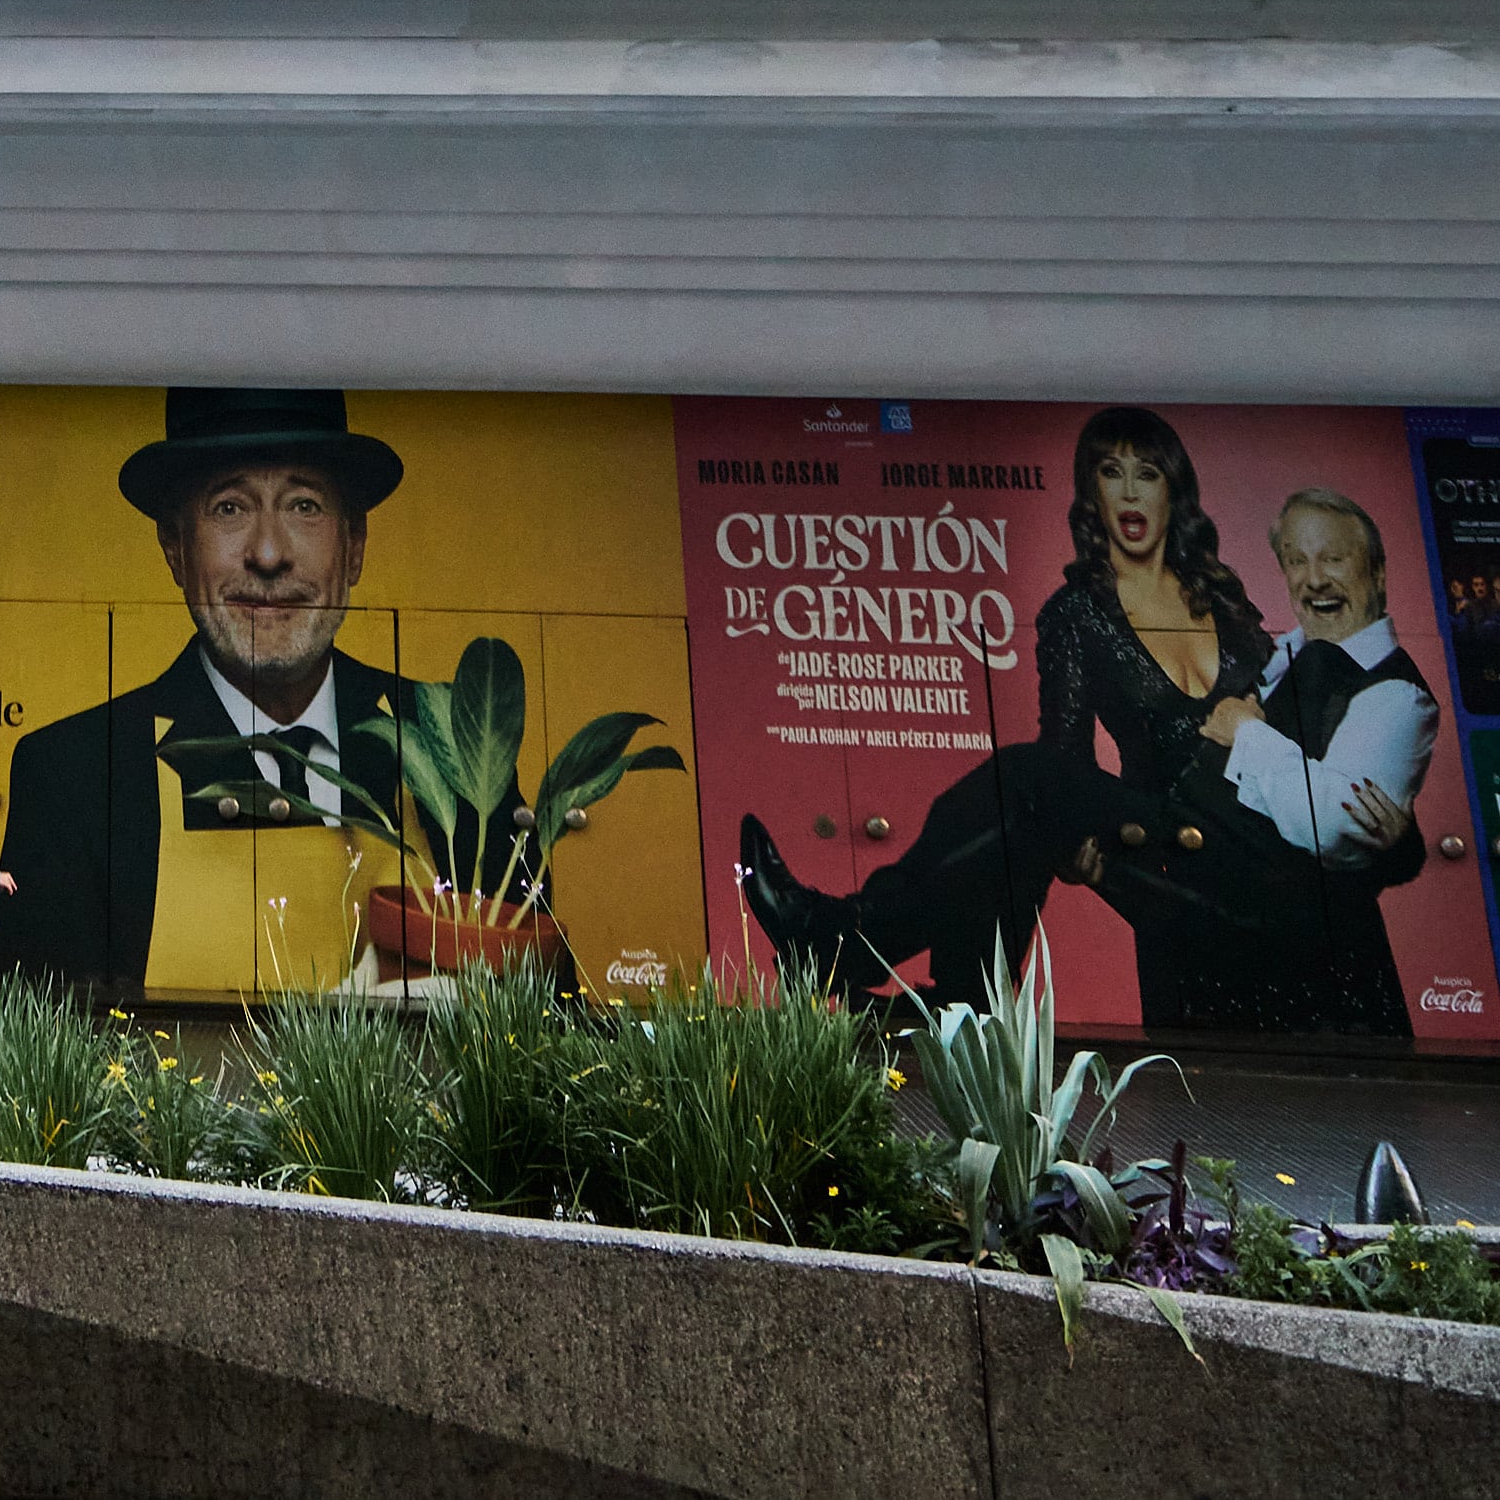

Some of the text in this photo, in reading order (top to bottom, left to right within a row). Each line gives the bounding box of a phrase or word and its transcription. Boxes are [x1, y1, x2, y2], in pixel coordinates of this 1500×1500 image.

[803, 418, 869, 433] Santander
[698, 458, 766, 486] MORIA
[880, 461, 942, 489] JORGE
[947, 463, 1046, 491] MARRALE
[715, 500, 1009, 575] CUESTIÓN
[724, 569, 1019, 671] DE GÉNERO
[789, 651, 886, 680] JADE-ROSE
[890, 655, 964, 683] PARKER
[777, 683, 971, 715] dirigida por NELSON VALENTE
[780, 726, 819, 745] PAULA
[819, 727, 860, 746] KOHAN
[866, 730, 899, 748] ARIEL
[900, 728, 936, 749] PÉREZ
[936, 732, 952, 750] DE
[953, 730, 994, 751] MARÍA
